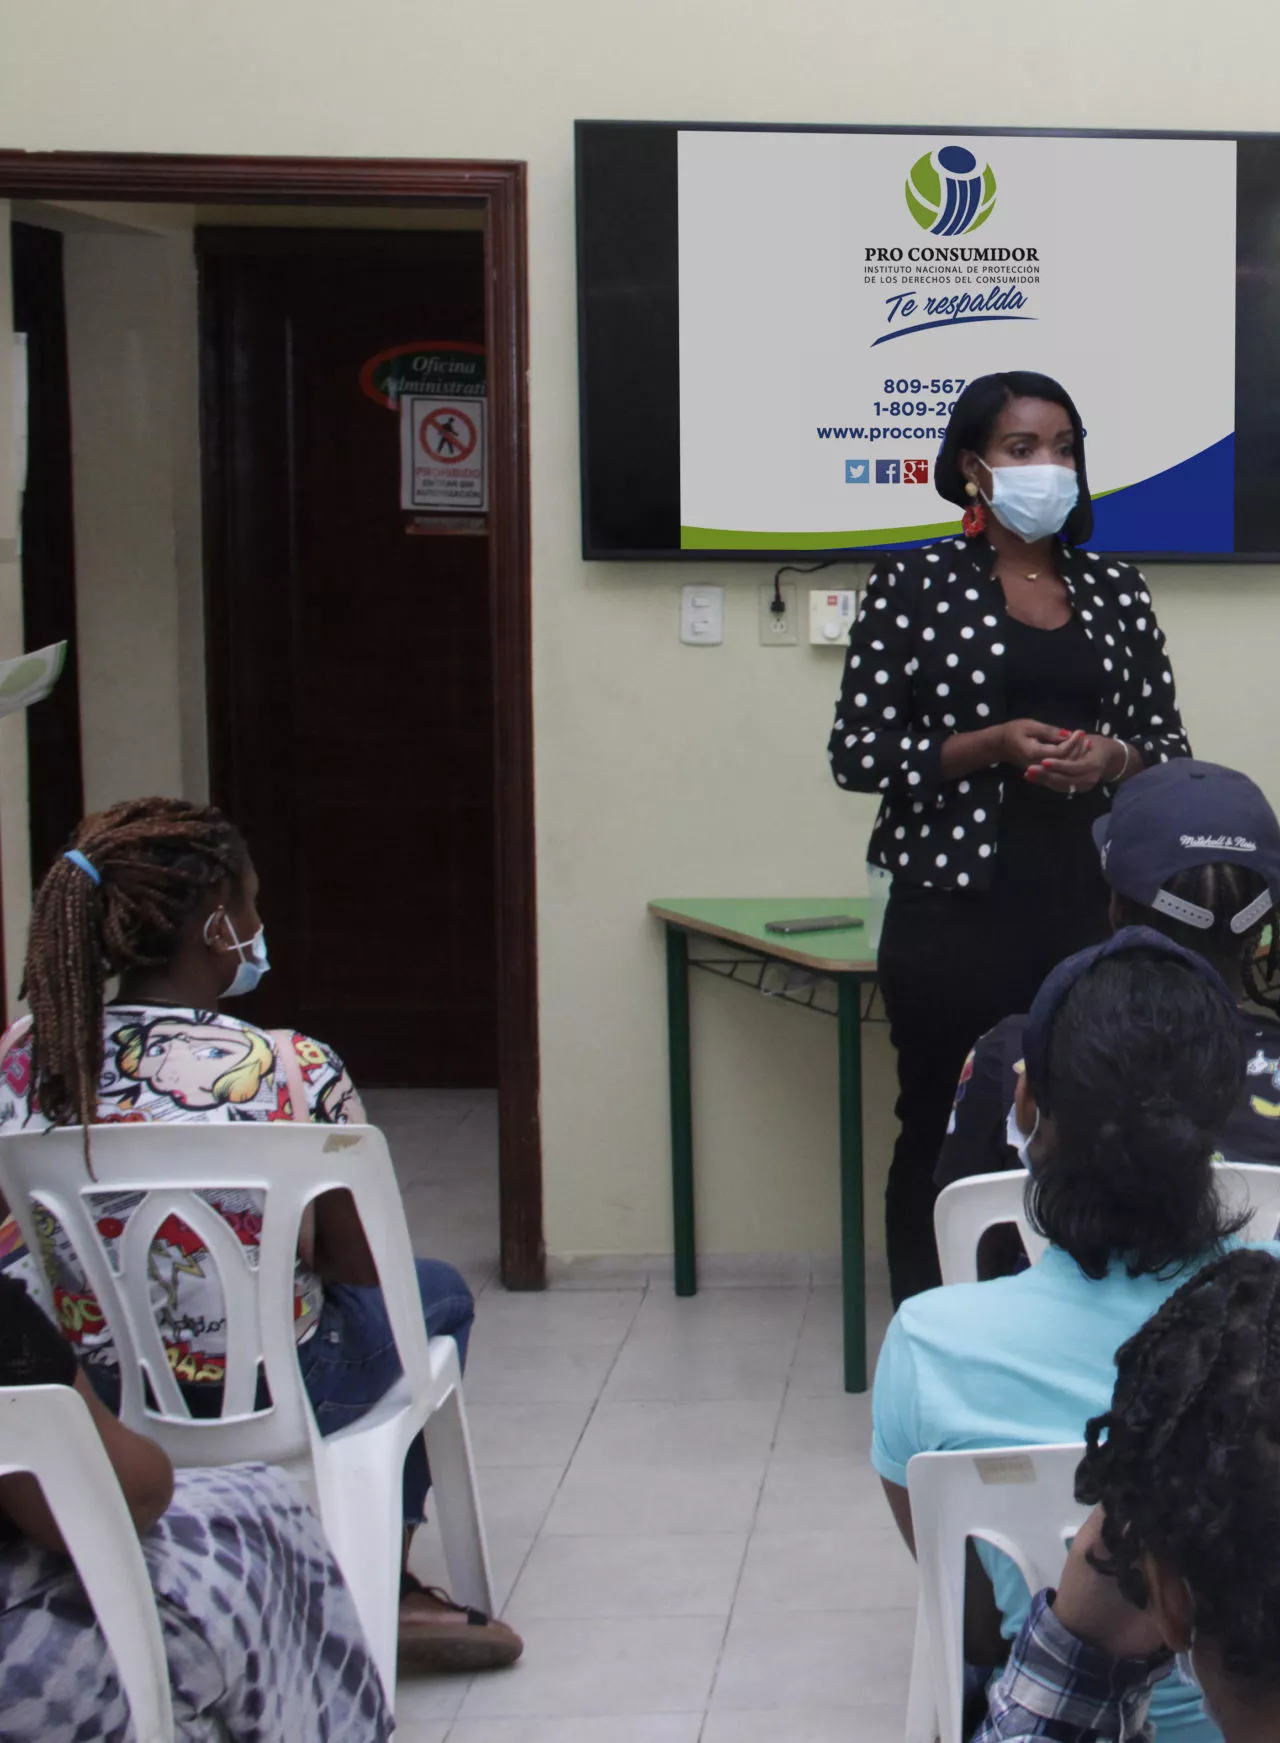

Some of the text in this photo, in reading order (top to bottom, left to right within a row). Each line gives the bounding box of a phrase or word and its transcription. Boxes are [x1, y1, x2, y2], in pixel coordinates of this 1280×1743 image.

[864, 247, 1040, 262] PRO CONSUMIDOR
[864, 264, 1040, 274] INSTITUTO NACIONAL DE PROTECCIÓN
[864, 275, 1040, 284] DE LOS DERECHOS DEL CONSUMIDOR
[885, 285, 1028, 323] Te respalda
[412, 355, 476, 374] Oficina
[883, 378, 969, 395] 809-567
